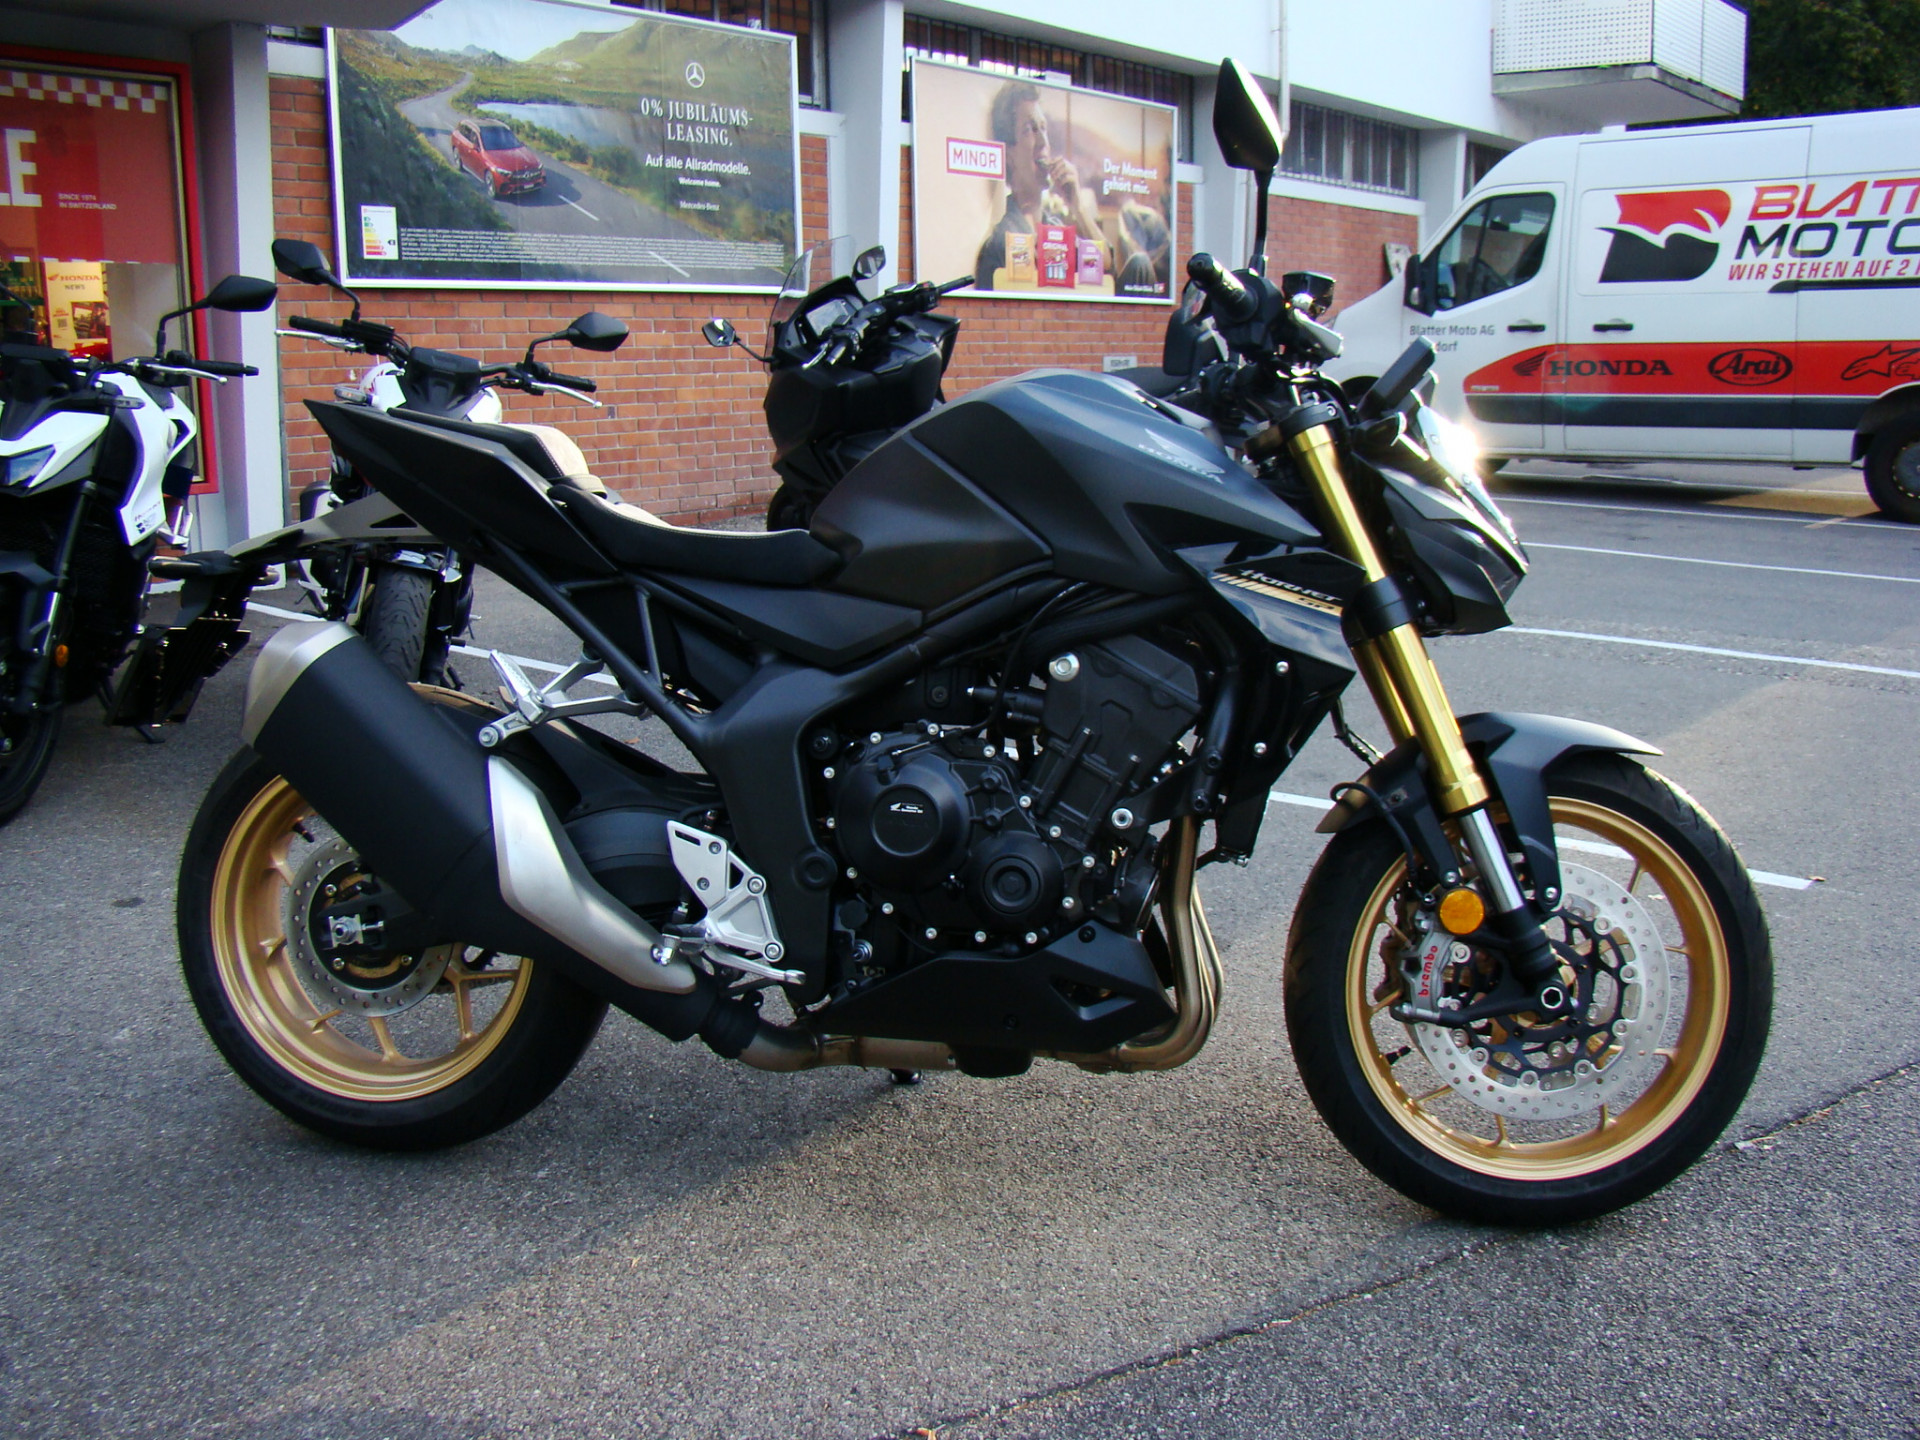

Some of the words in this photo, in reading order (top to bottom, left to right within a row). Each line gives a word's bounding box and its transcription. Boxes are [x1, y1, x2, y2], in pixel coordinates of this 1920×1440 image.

[641, 98, 664, 117] 0%
[668, 101, 754, 127] JUBILÄUMS-
[667, 123, 733, 147] LEASING.
[0, 128, 42, 207] E
[645, 154, 664, 168] Auf
[665, 156, 683, 169] alle
[685, 157, 751, 175] Allradmodelle.
[953, 147, 997, 169] MINOR
[1103, 158, 1121, 174] Der
[1122, 161, 1157, 180] Moment
[1103, 176, 1132, 195] gehört
[1734, 219, 1920, 260] MOTO
[1728, 264, 1768, 281] WIR
[1772, 261, 1849, 279] STEHEN
[1852, 259, 1893, 277] AUF
[1896, 259, 1910, 276] 2
[1409, 325, 1446, 336] Blatter
[1449, 325, 1478, 336] Moto
[1479, 325, 1496, 336] AG
[1549, 360, 1674, 376] HONDA
[1715, 353, 1784, 376] Arai
[1418, 945, 1438, 997] brembo
